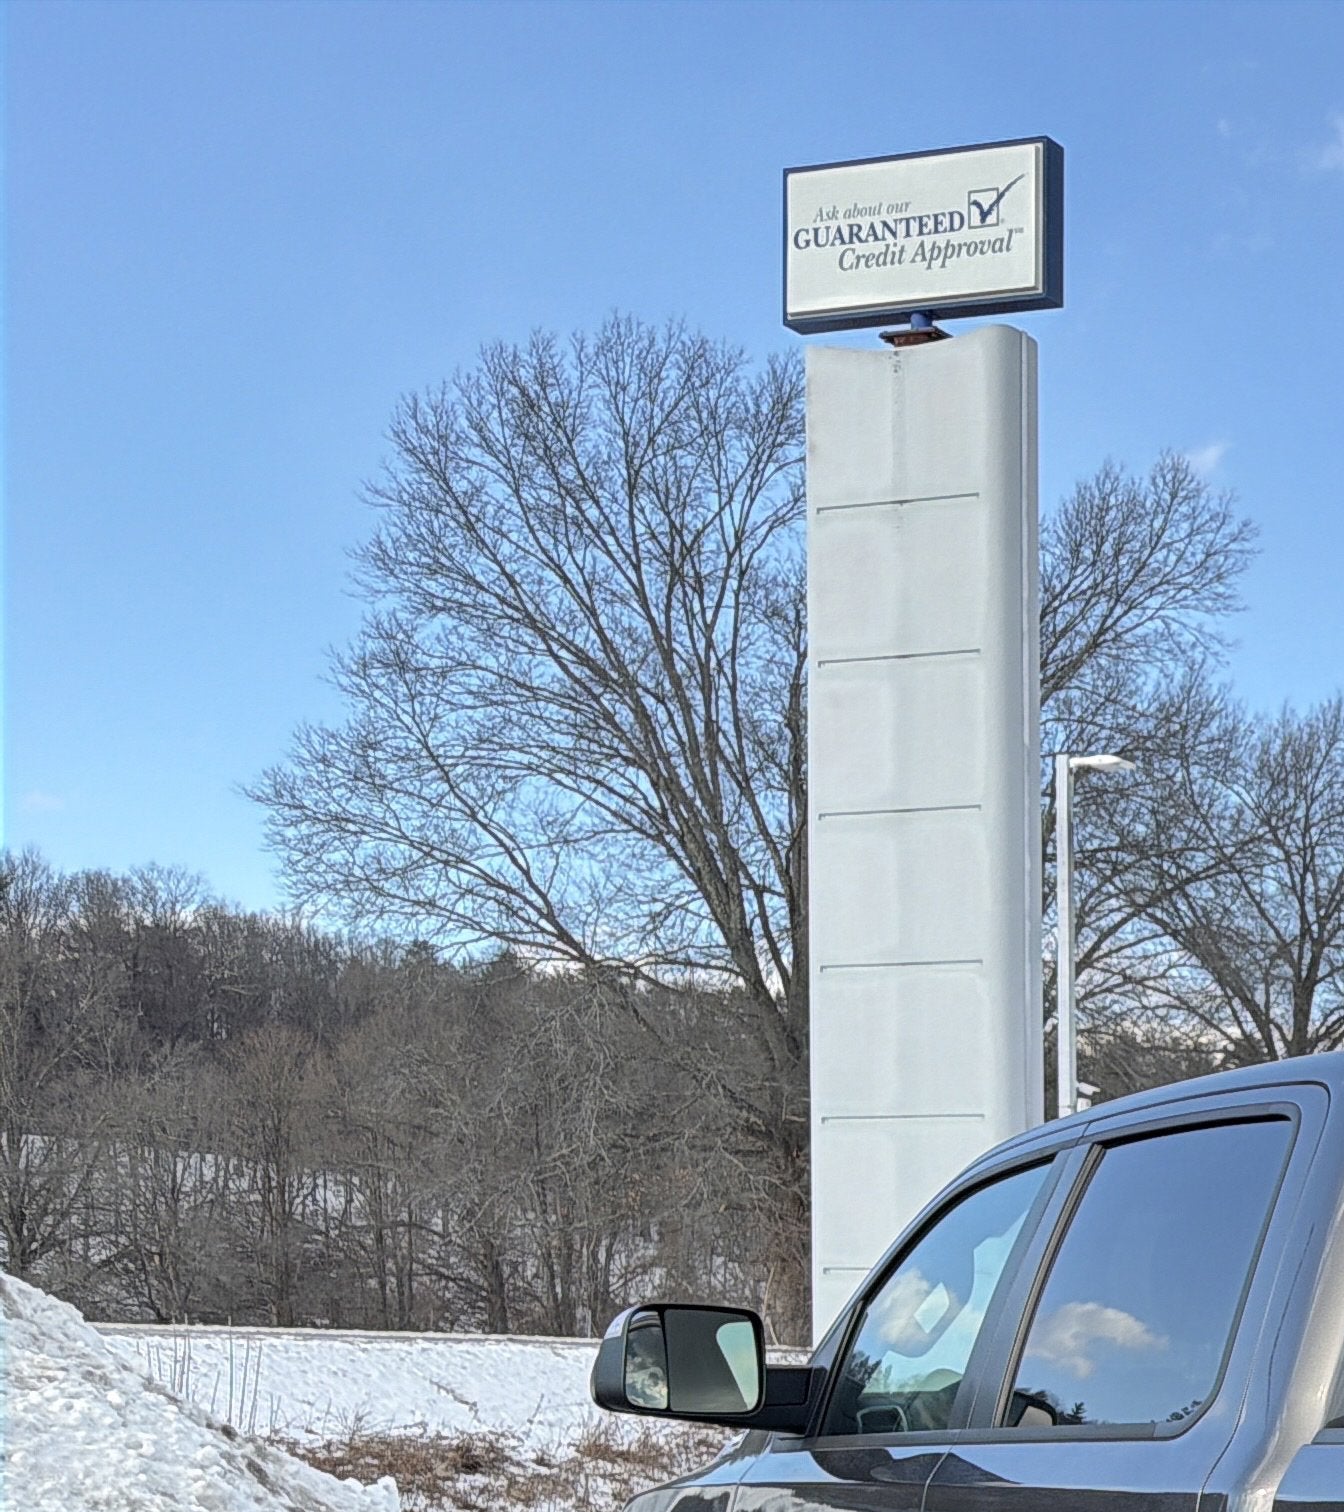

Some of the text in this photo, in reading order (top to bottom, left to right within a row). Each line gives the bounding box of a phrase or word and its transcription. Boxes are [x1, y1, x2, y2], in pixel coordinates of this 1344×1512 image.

[793, 210, 965, 250] GUARANTEED
[812, 200, 912, 223] Ask about our
[838, 227, 1013, 271] Credit Approval
